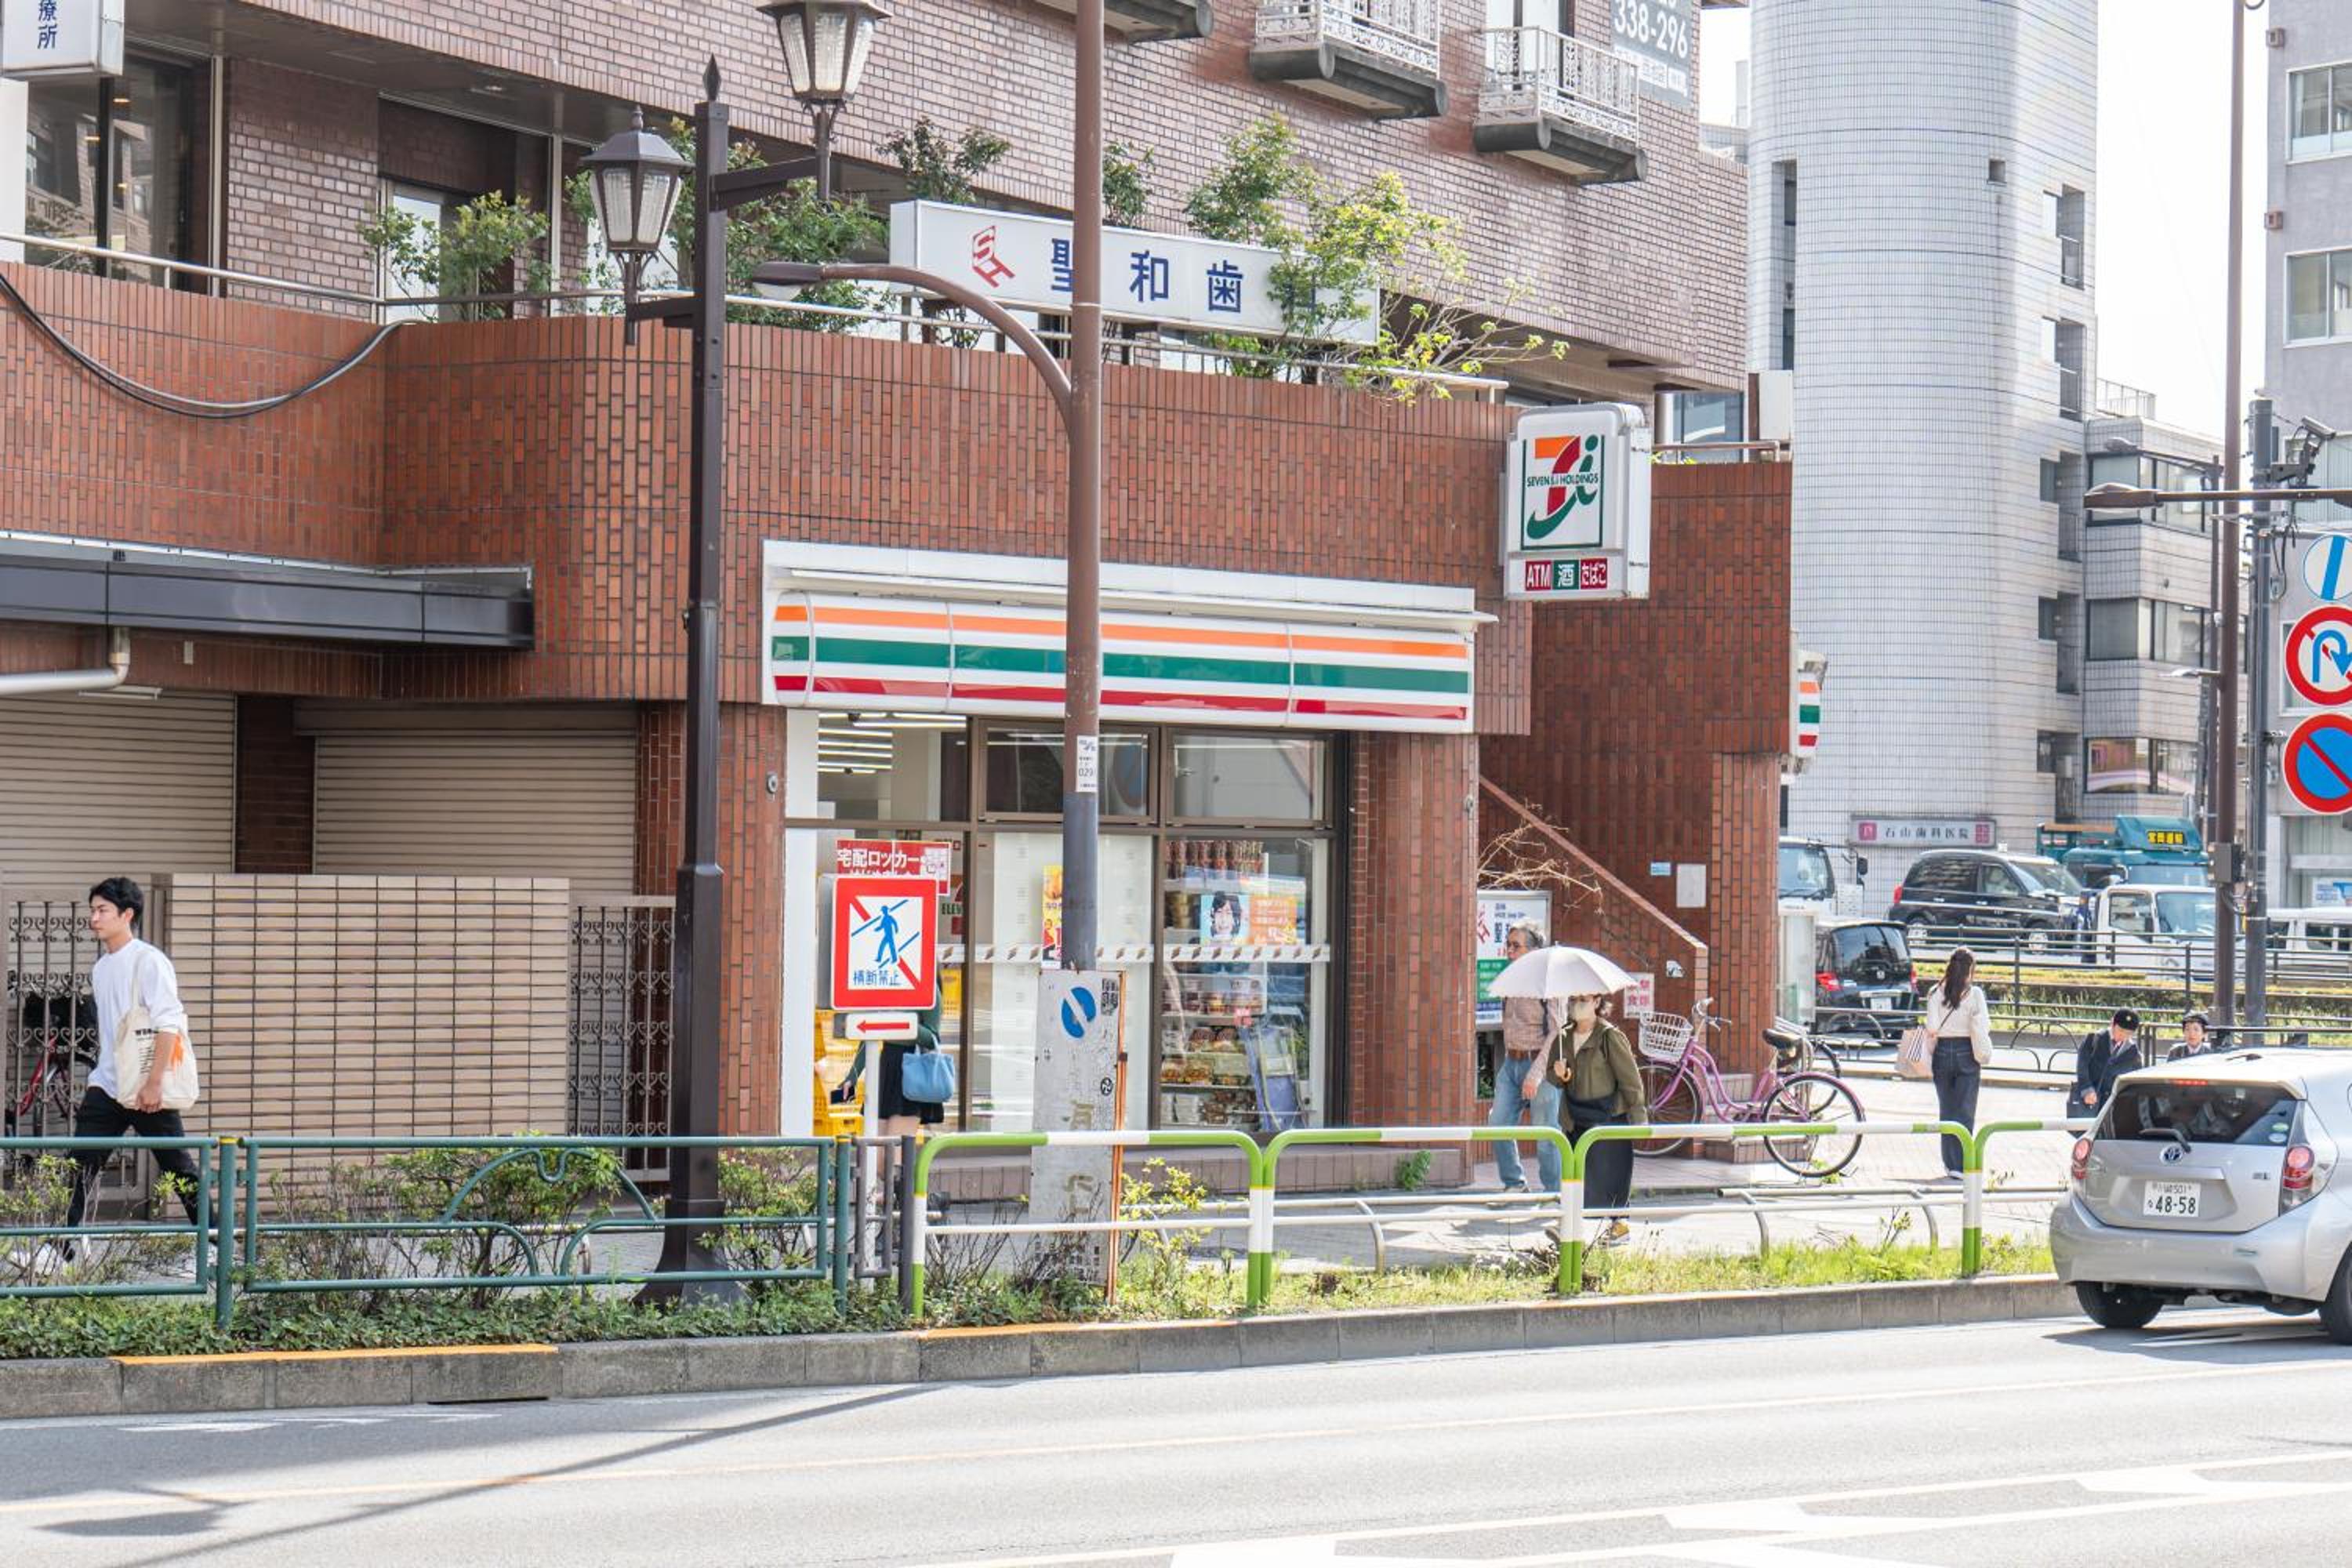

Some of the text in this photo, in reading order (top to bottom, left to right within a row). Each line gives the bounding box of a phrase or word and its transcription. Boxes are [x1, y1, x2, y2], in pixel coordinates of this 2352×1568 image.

[1614, 0, 1689, 59] 338-296
[1051, 237, 1317, 314] 聖和歯
[1526, 563, 1550, 588] ATM
[1558, 564, 1575, 588] 酒
[1581, 562, 1606, 586] たばこ
[837, 848, 920, 868] 宅配ロッカー
[852, 969, 902, 986] 横断禁止
[2156, 1196, 2196, 1214] 48-58
